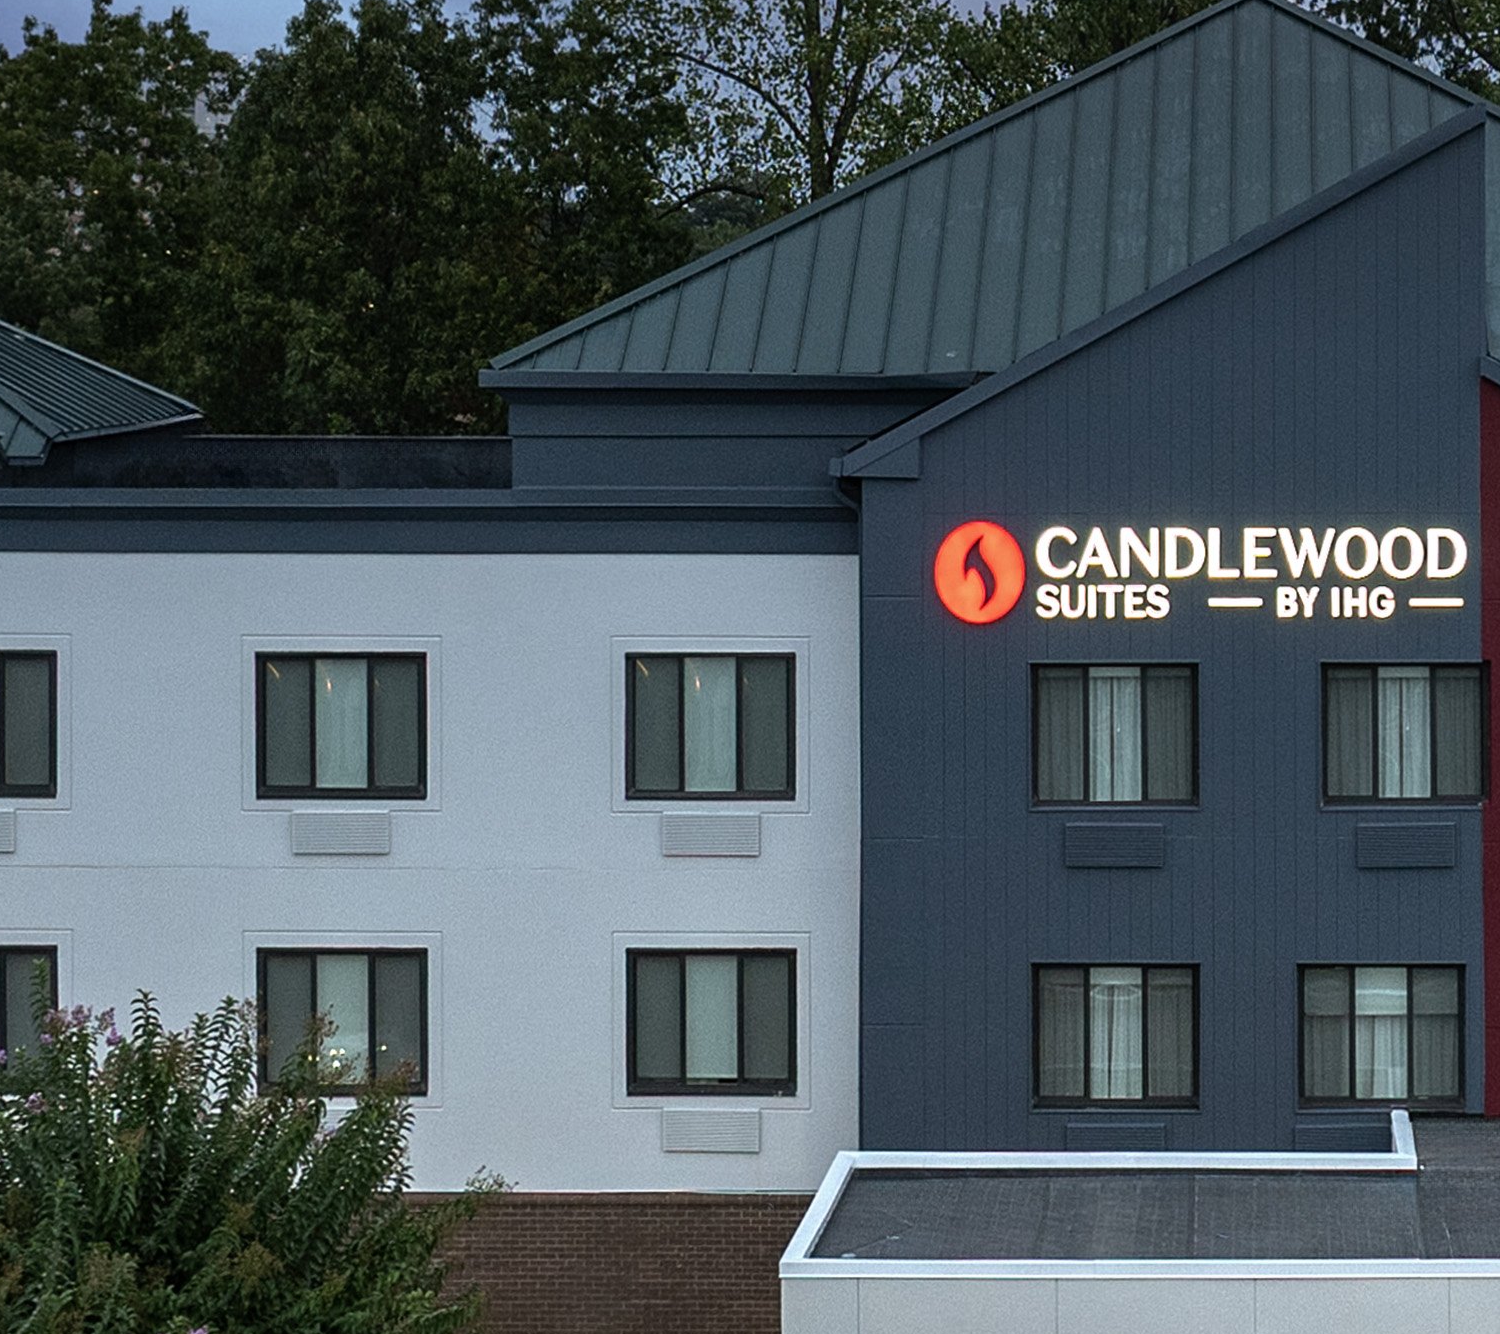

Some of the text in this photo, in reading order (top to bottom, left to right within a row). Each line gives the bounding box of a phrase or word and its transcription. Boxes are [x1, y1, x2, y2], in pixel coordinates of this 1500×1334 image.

[1034, 524, 1469, 580] CANDLEWOOD
[1034, 582, 1172, 620] SUITES
[1275, 584, 1397, 620] BY IHG
